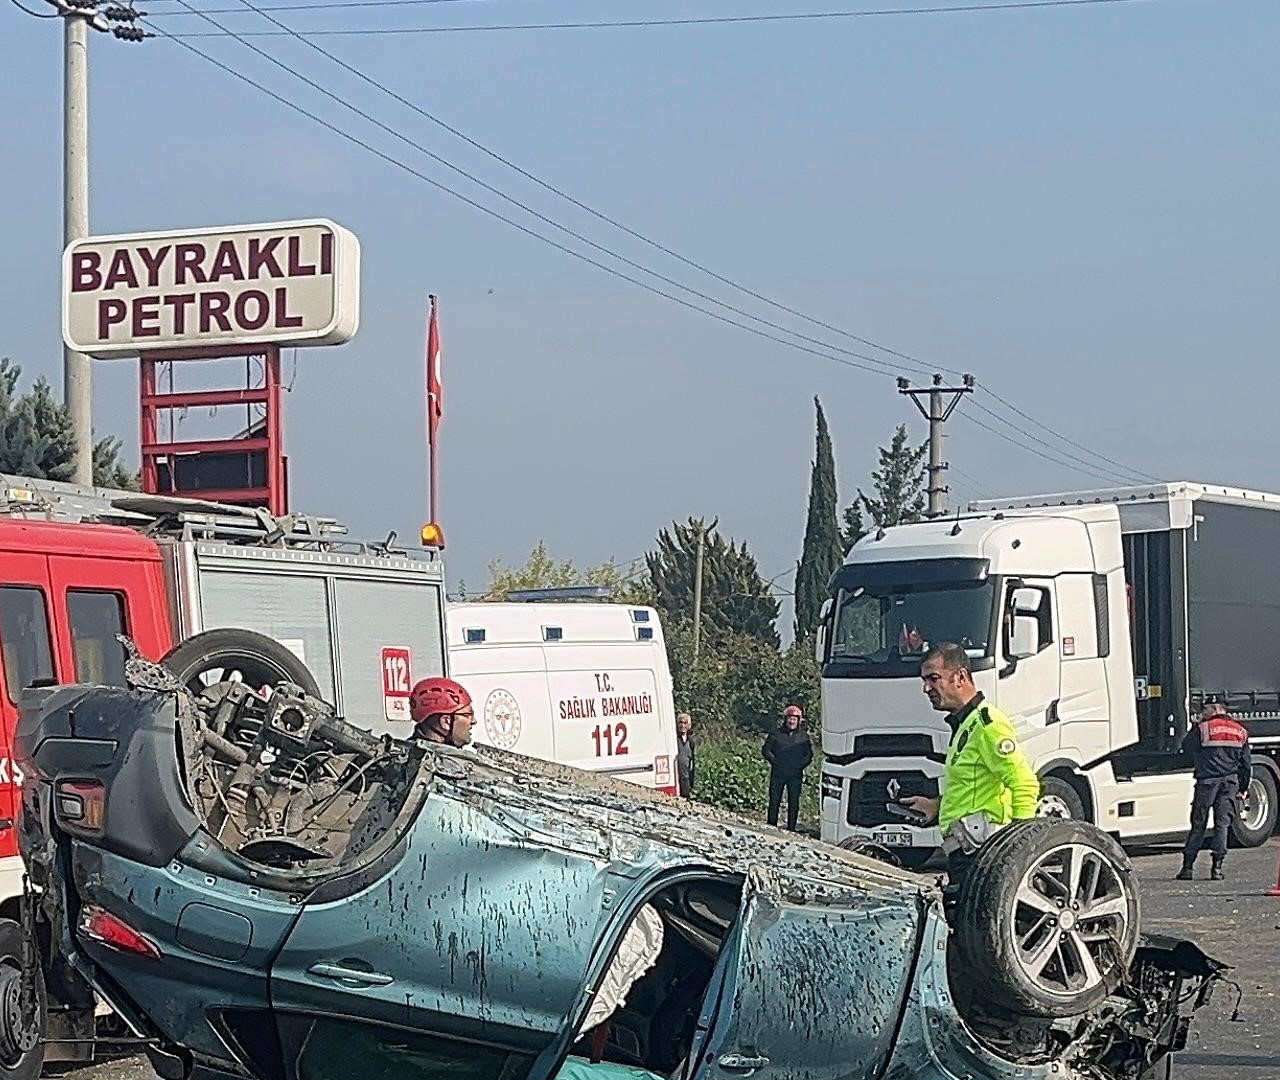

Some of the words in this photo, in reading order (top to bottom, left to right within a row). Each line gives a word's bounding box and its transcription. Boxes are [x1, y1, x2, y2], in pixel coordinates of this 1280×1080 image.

[72, 234, 333, 293] BAYRAKLI
[98, 288, 303, 340] PETROL
[385, 656, 409, 692] 112
[594, 673, 614, 693] T.C.
[559, 695, 597, 720] SAĞLIK
[601, 691, 653, 717] BAKANLIĞI
[591, 722, 629, 757] 112
